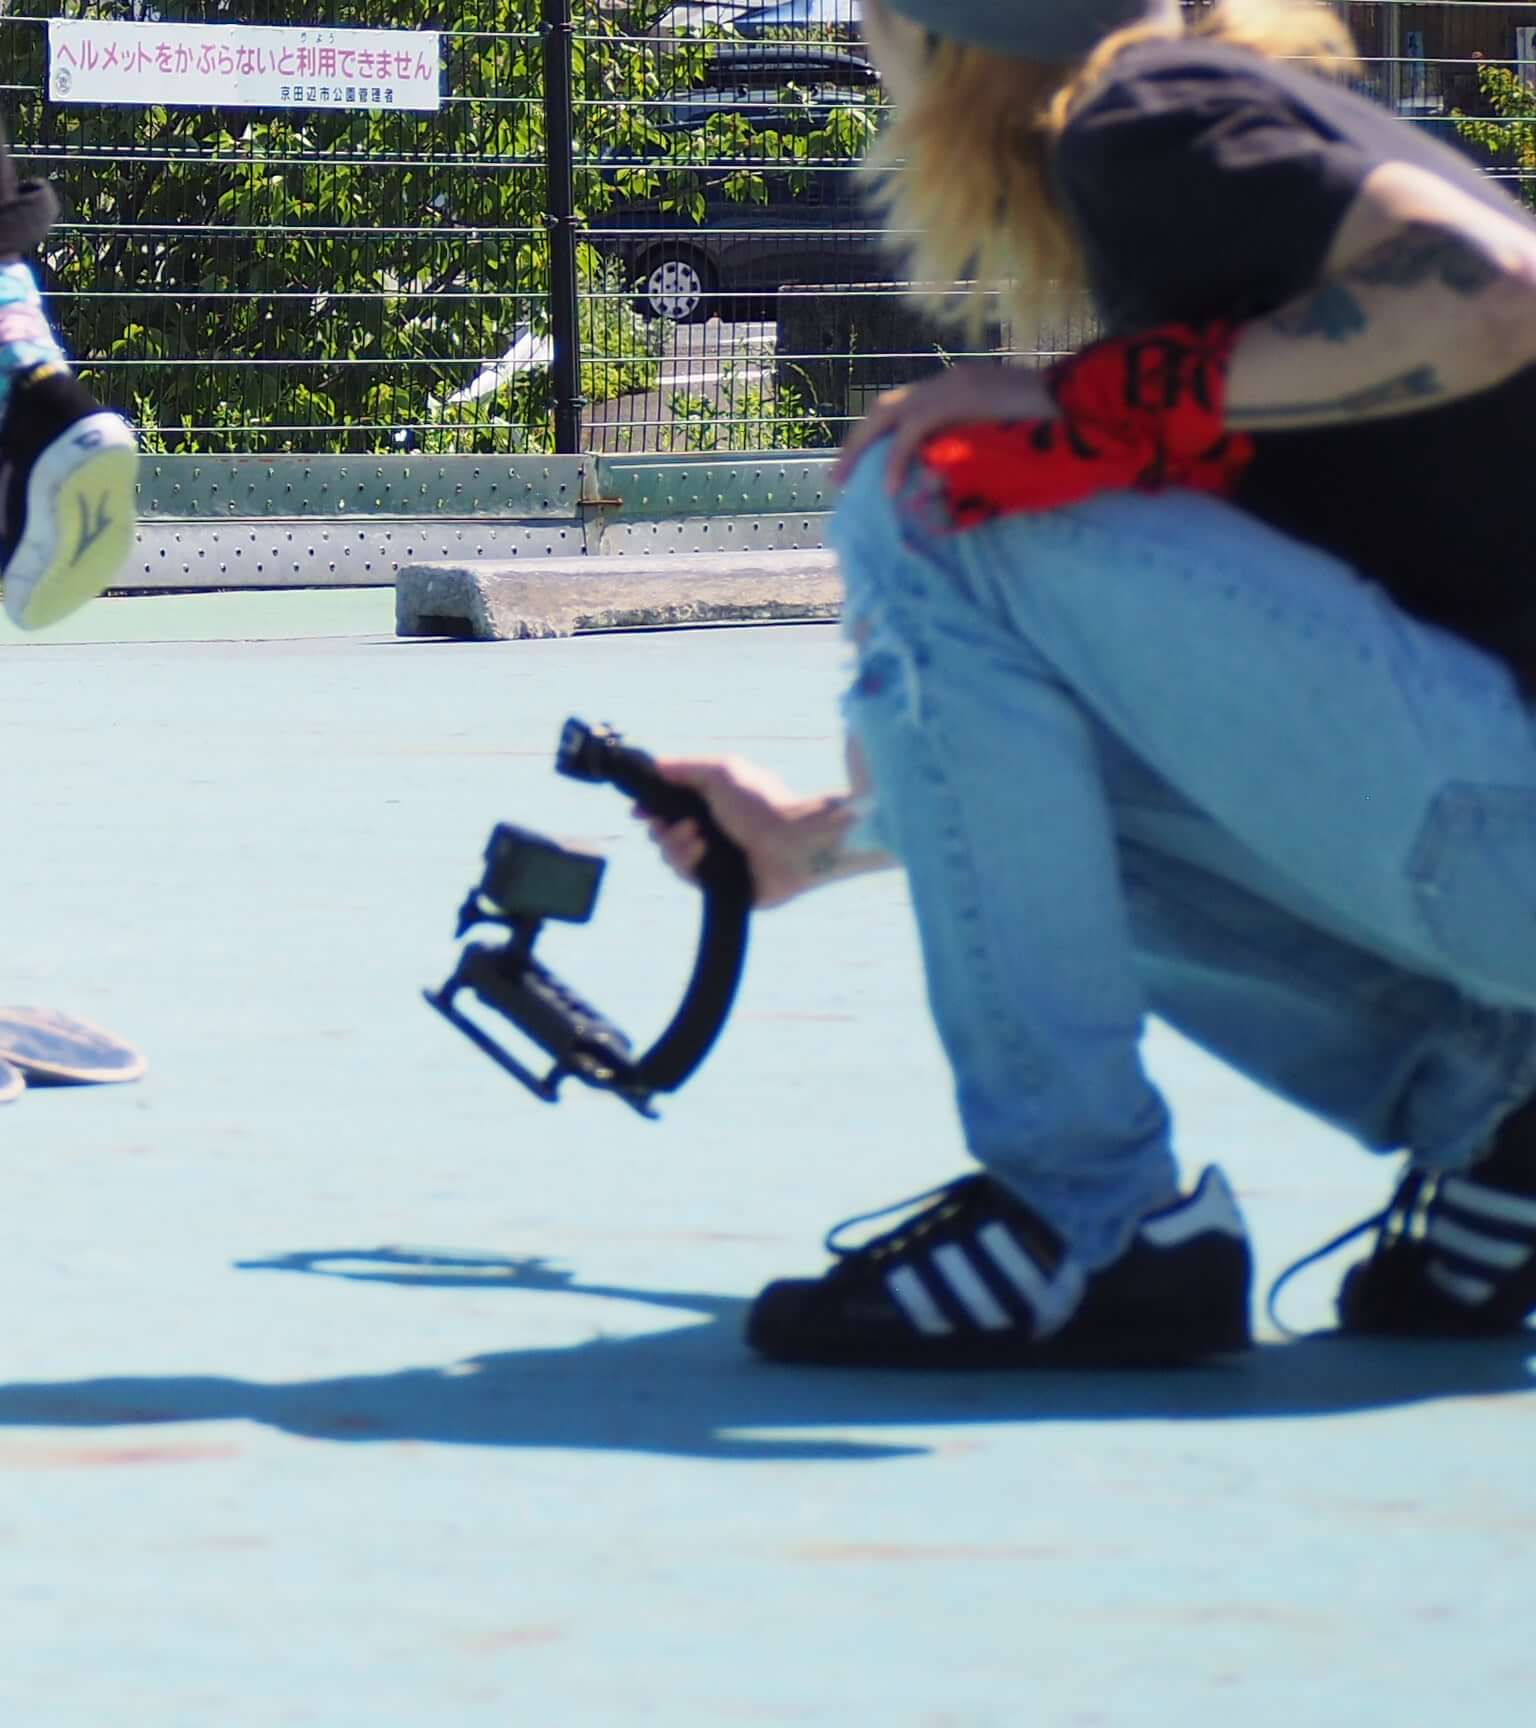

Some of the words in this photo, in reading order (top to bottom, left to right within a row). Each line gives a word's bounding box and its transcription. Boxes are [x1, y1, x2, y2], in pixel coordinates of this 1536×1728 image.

[56, 40, 432, 81] ヘルメットをかぶらないと利用できません
[280, 85, 394, 104] 京田辺市公園管理者
